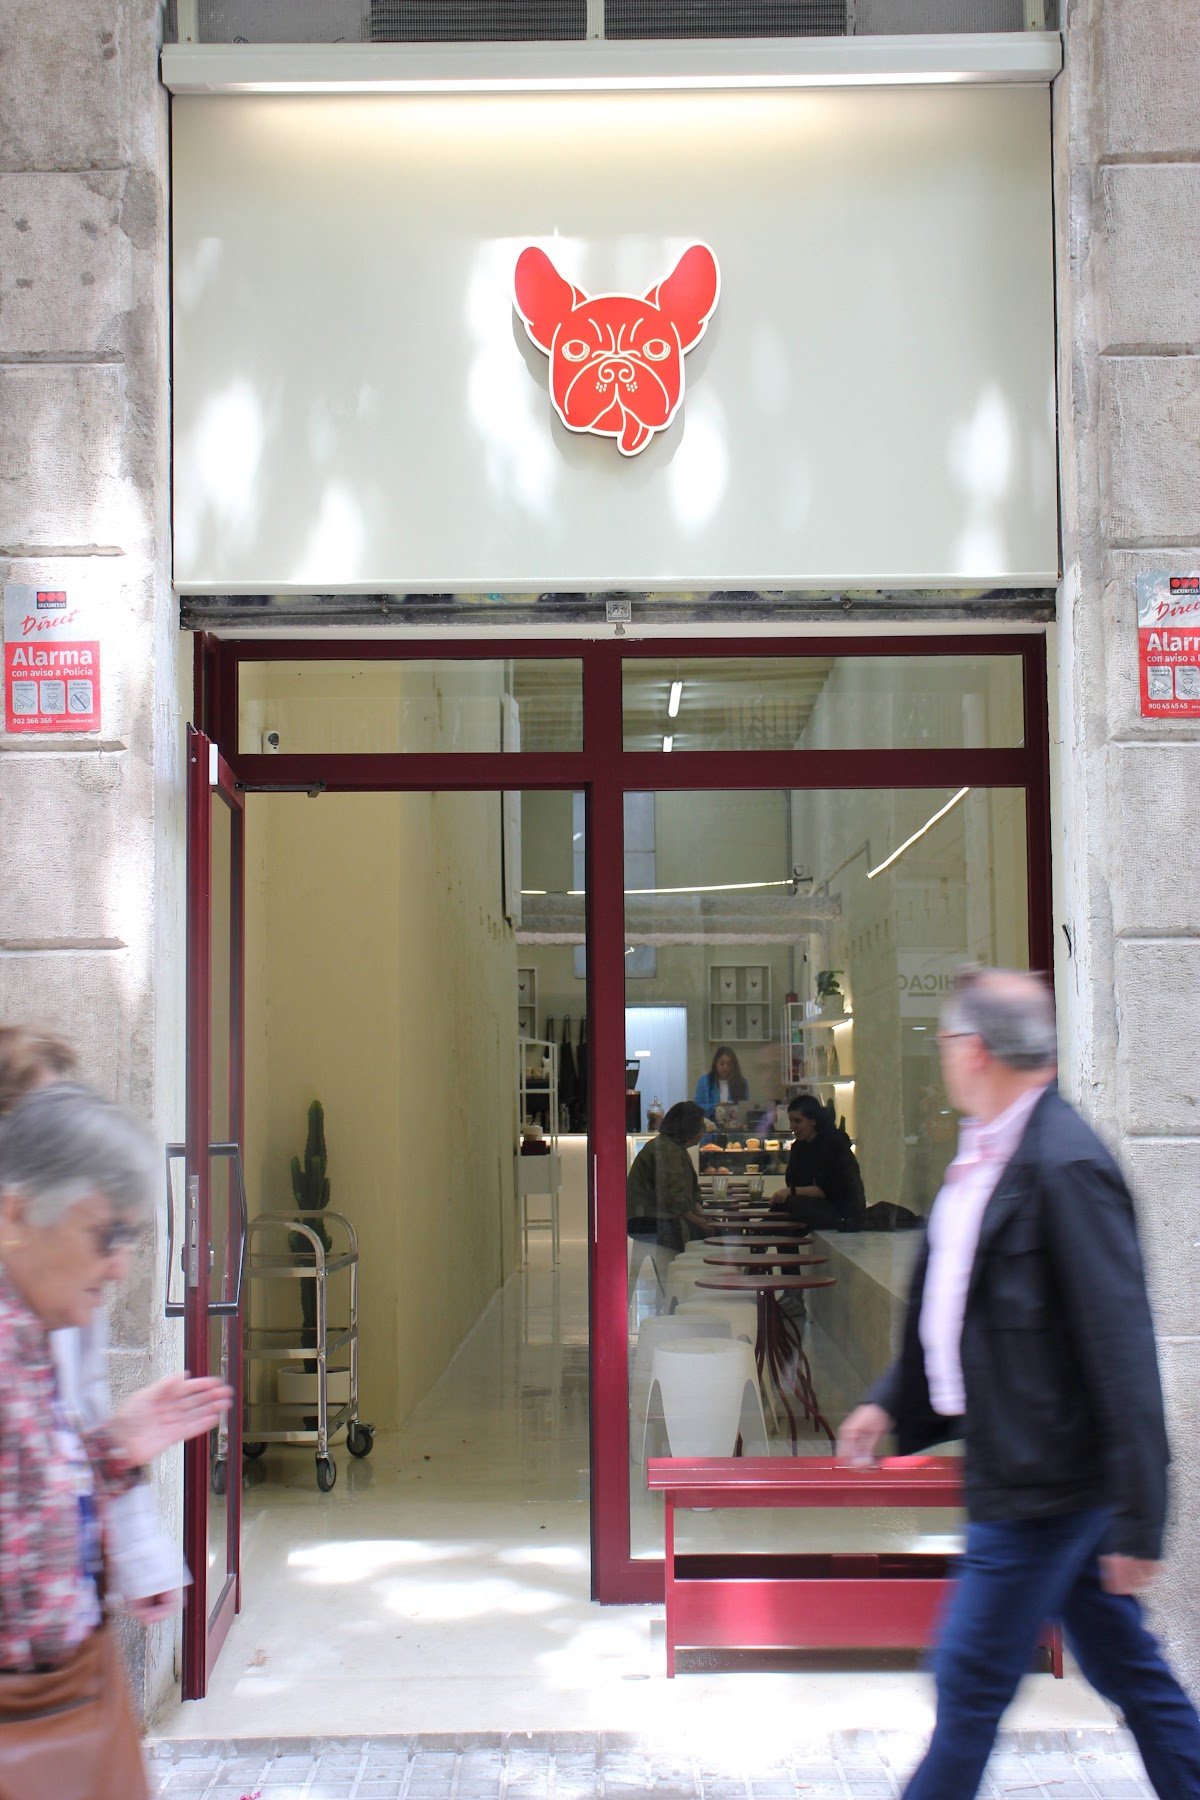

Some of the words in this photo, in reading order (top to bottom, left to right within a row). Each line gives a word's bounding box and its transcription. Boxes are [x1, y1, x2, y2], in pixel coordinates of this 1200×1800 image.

[21, 609, 80, 635] Direct
[12, 647, 92, 666] Alarma
[1165, 653, 1188, 662] aviso
[30, 668, 53, 677] aviso
